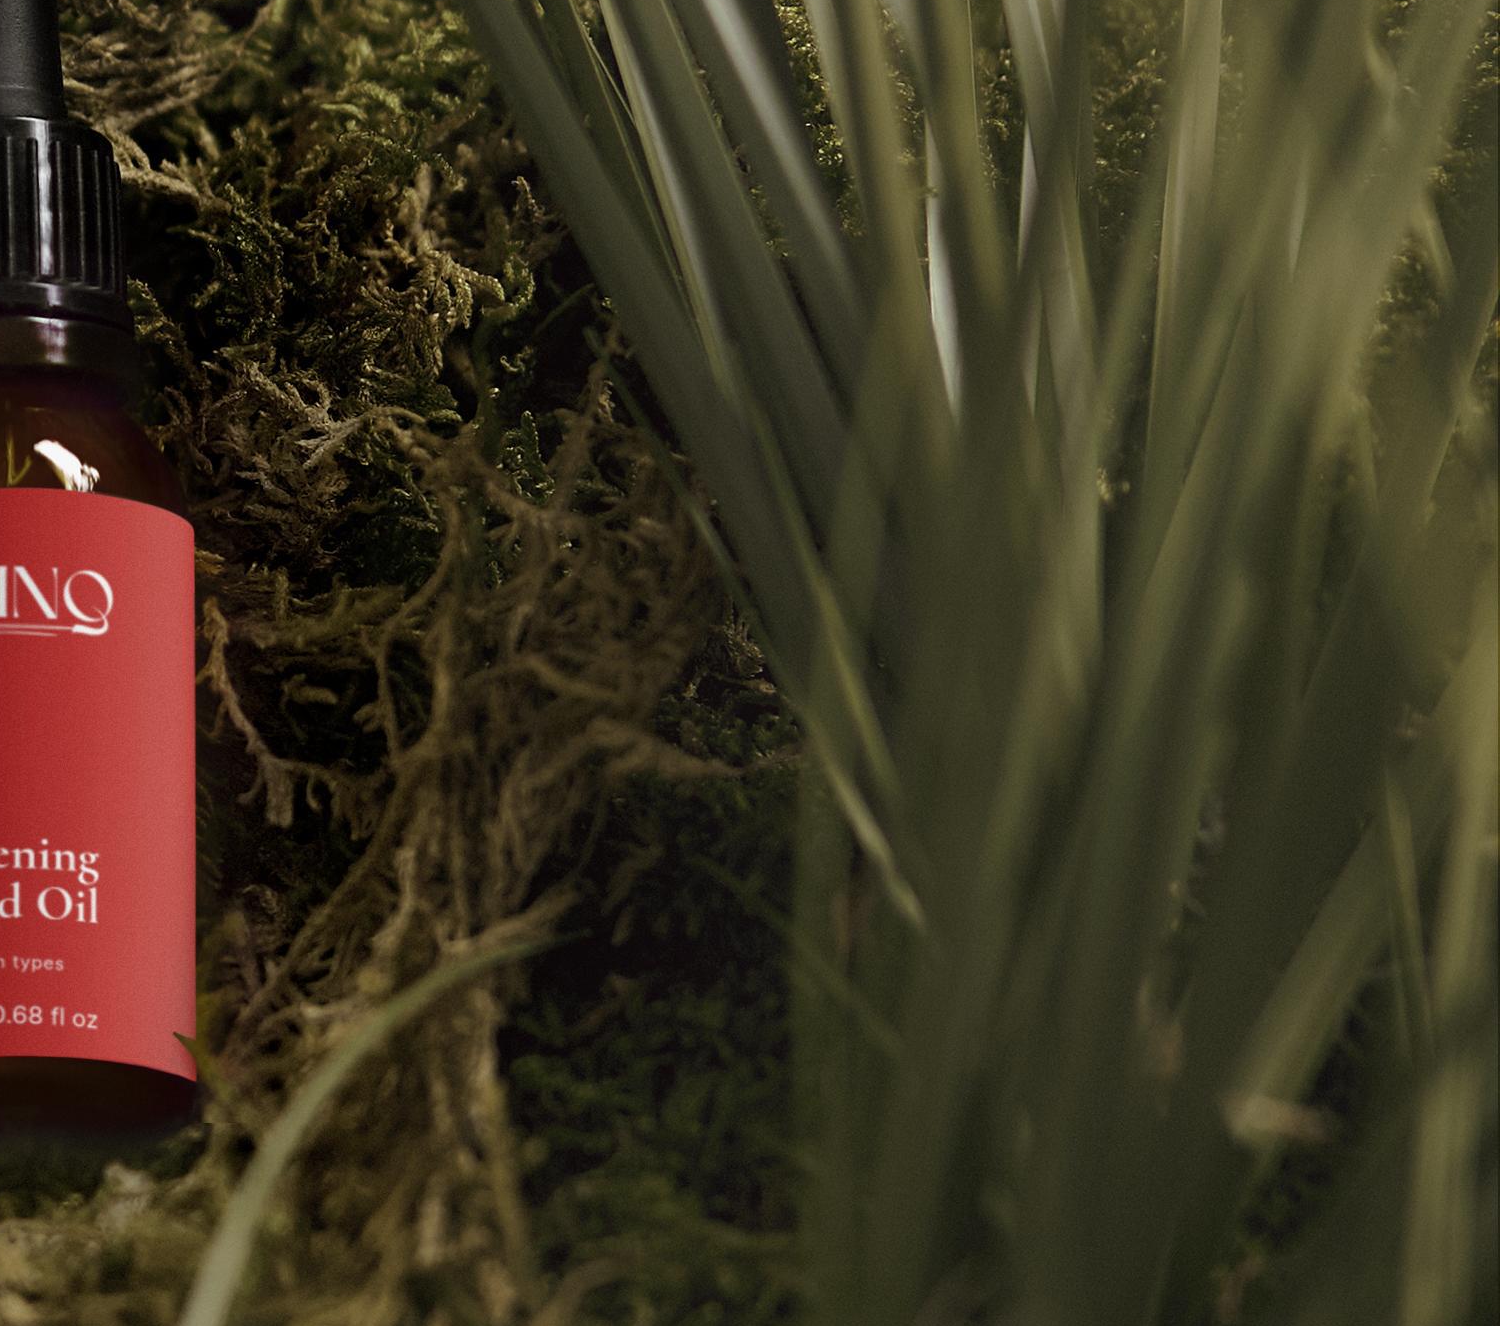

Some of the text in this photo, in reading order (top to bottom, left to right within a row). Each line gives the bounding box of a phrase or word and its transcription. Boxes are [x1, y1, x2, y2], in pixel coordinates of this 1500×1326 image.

[37, 886, 98, 924] Oil
[12, 956, 65, 973] types
[51, 1007, 65, 1026] fl
[72, 1014, 98, 1030] oz
